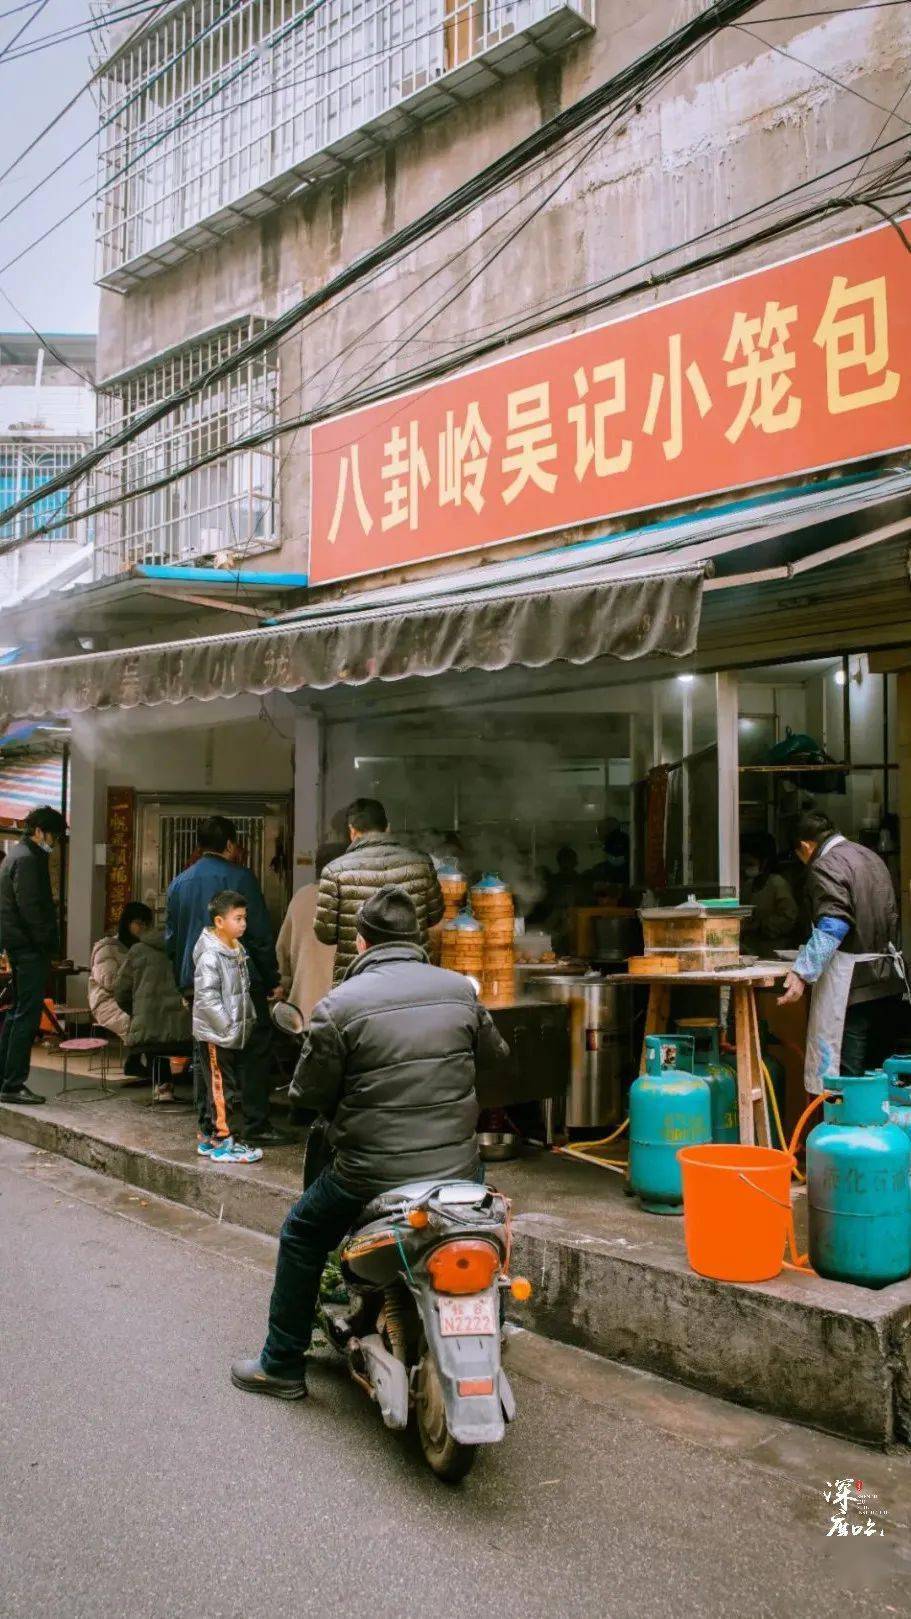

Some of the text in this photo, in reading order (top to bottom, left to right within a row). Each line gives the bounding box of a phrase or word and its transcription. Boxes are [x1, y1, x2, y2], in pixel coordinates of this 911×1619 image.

[327, 275, 901, 544] 八卦岭吴记小笼包
